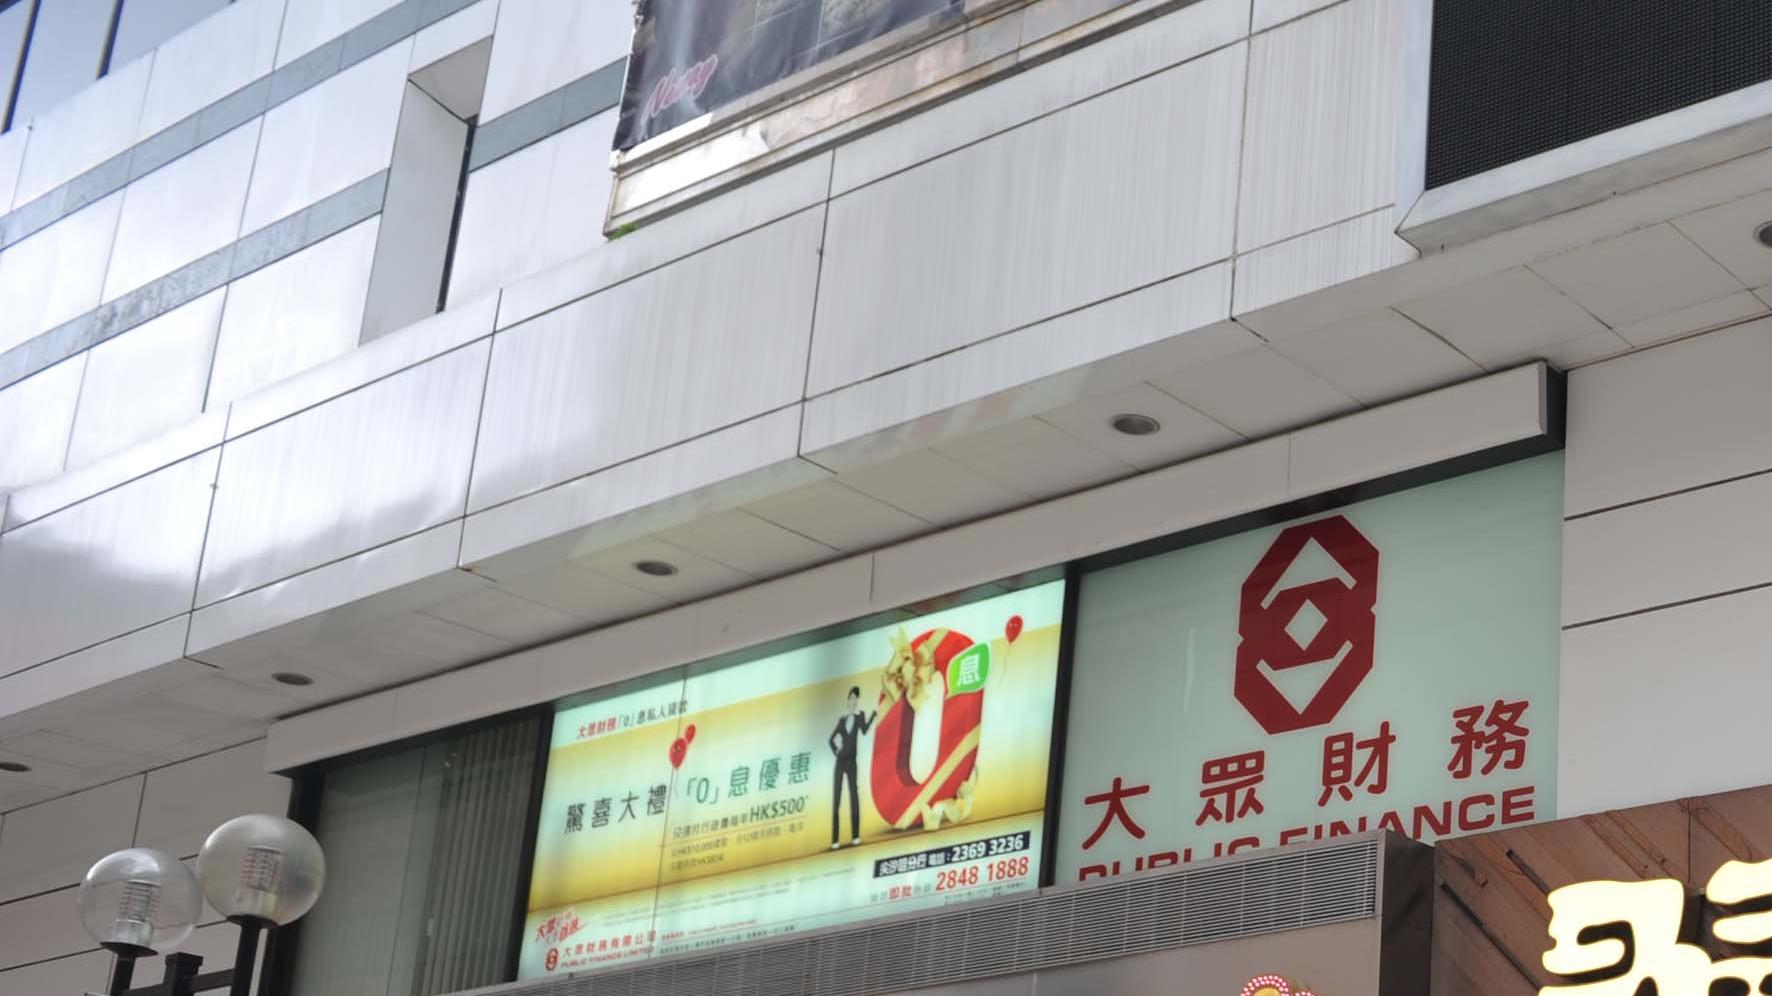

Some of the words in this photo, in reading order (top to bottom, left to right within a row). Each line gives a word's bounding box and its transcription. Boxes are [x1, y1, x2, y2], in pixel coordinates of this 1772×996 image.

[1082, 700, 1530, 850] 大眾財務
[951, 842, 987, 862] 2369
[989, 834, 1024, 856] 3236
[936, 866, 979, 892] 2848
[987, 857, 1029, 881] 1888
